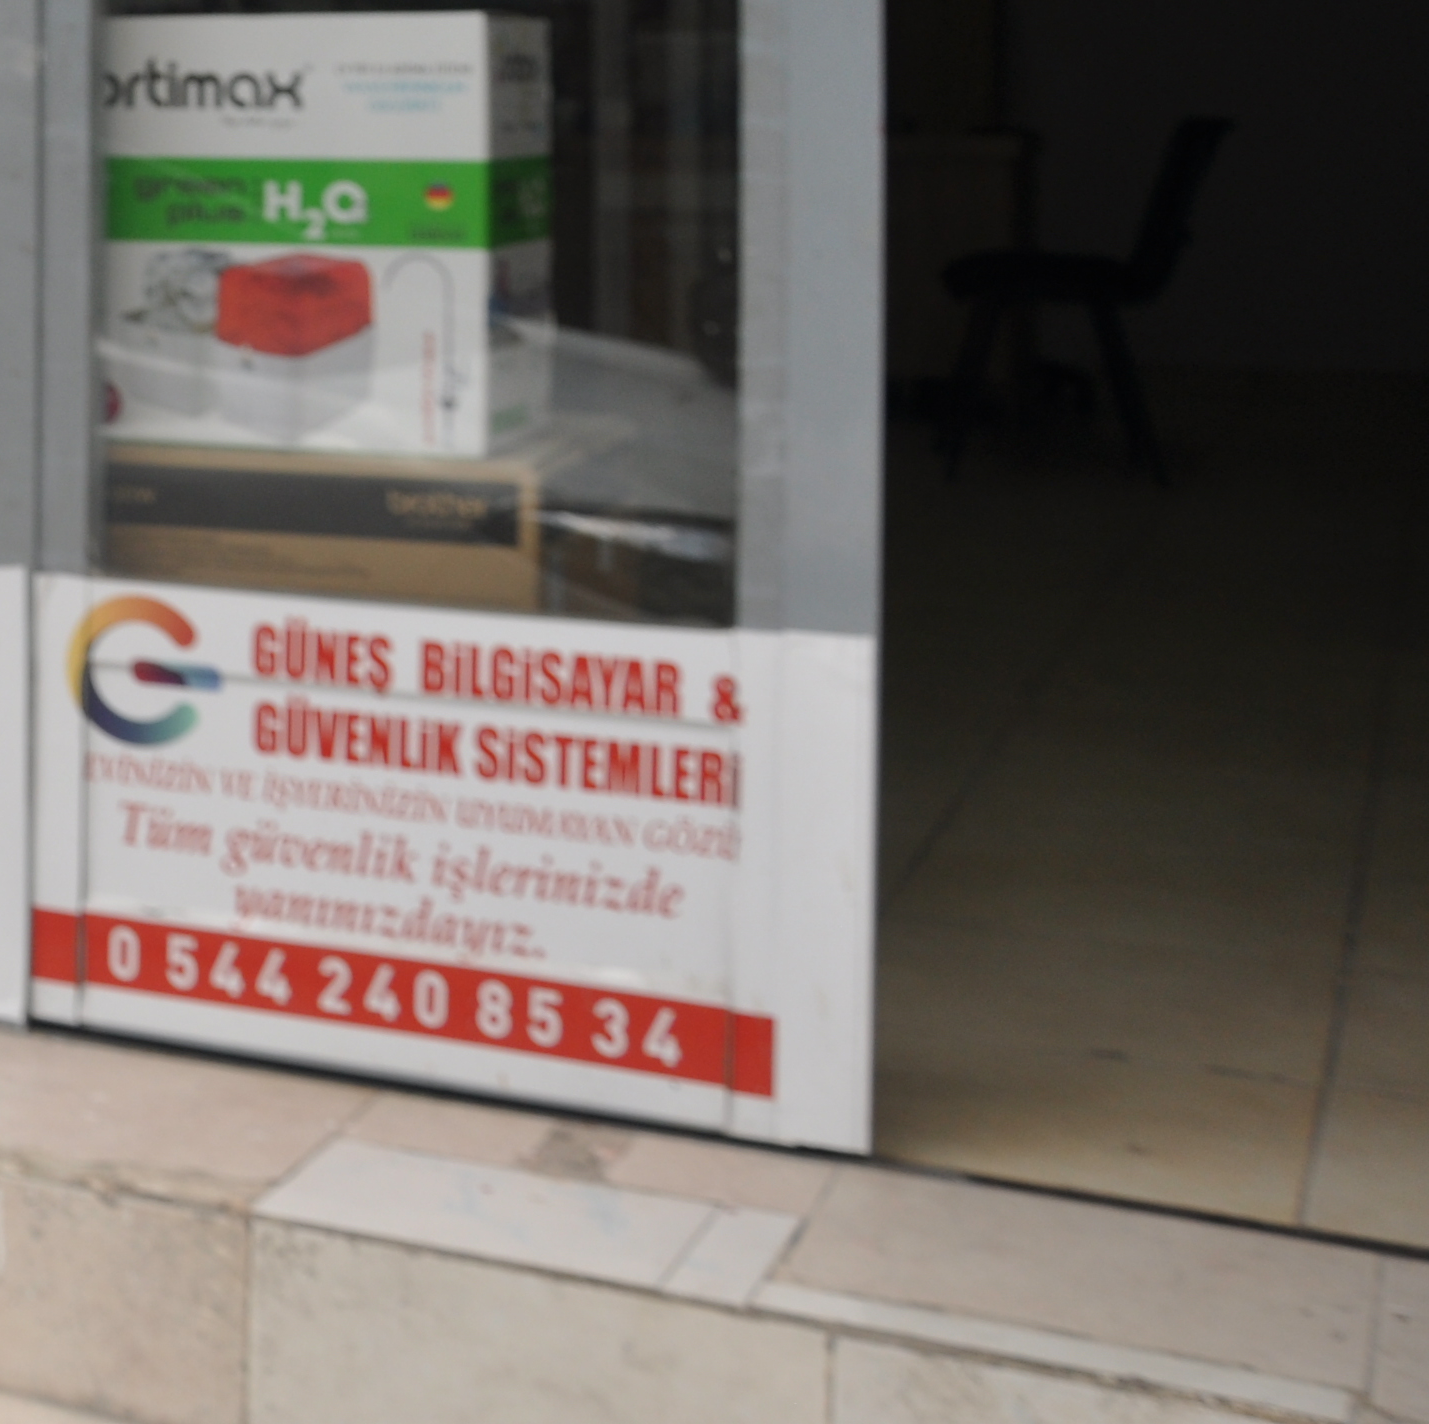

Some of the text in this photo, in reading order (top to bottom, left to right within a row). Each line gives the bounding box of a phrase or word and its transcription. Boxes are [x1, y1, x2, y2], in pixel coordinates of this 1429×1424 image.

[253, 616, 393, 695] GÜNEŞ
[708, 674, 745, 725] &
[119, 798, 686, 921] Tüm güvenlik işlerinizde
[107, 924, 683, 1069] 0 544 240 85 34
